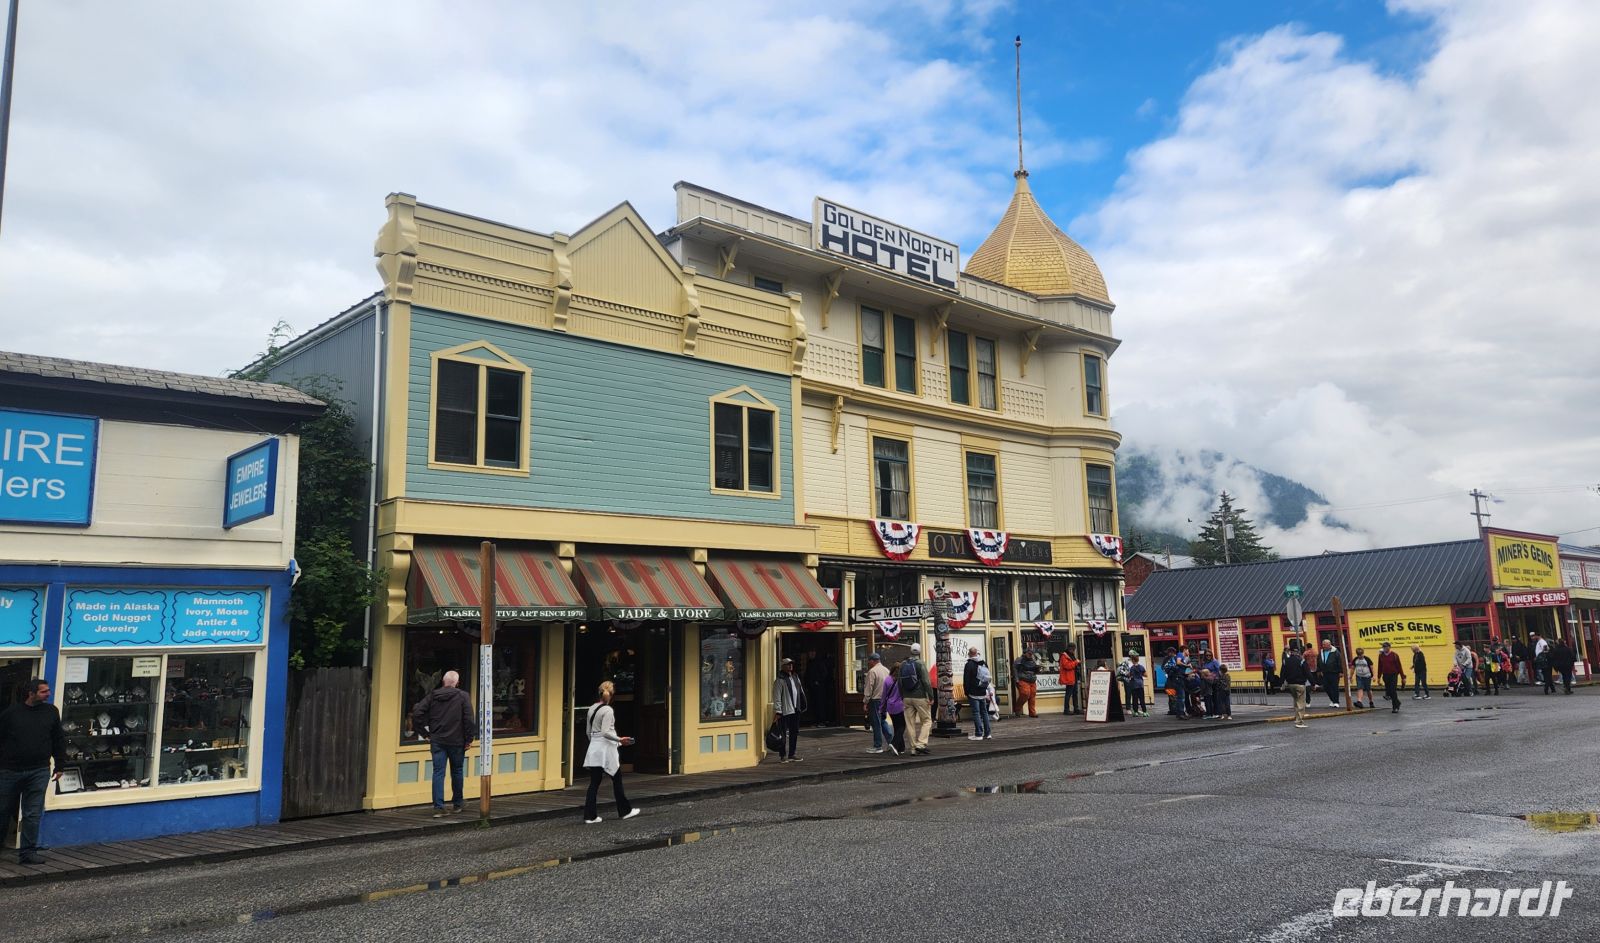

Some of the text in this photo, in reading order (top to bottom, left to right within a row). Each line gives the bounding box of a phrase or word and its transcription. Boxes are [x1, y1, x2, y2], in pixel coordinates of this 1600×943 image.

[824, 203, 953, 263] GOLDEN NORTH
[822, 224, 956, 289] HOTEL
[236, 458, 265, 484] EMPIRE
[229, 481, 268, 510] JEWELERS
[1498, 542, 1529, 566] MINER'S
[1530, 544, 1553, 569] GEMS
[1507, 592, 1566, 604] MINER'S GEMS
[75, 602, 160, 611] Made in Alaska
[186, 608, 213, 616] Ivory,
[618, 608, 711, 618] JADE & IVORY
[83, 613, 152, 623] Gold Nugget
[95, 625, 138, 634] Jewelry
[1359, 621, 1442, 638] MINER'S GEMS
